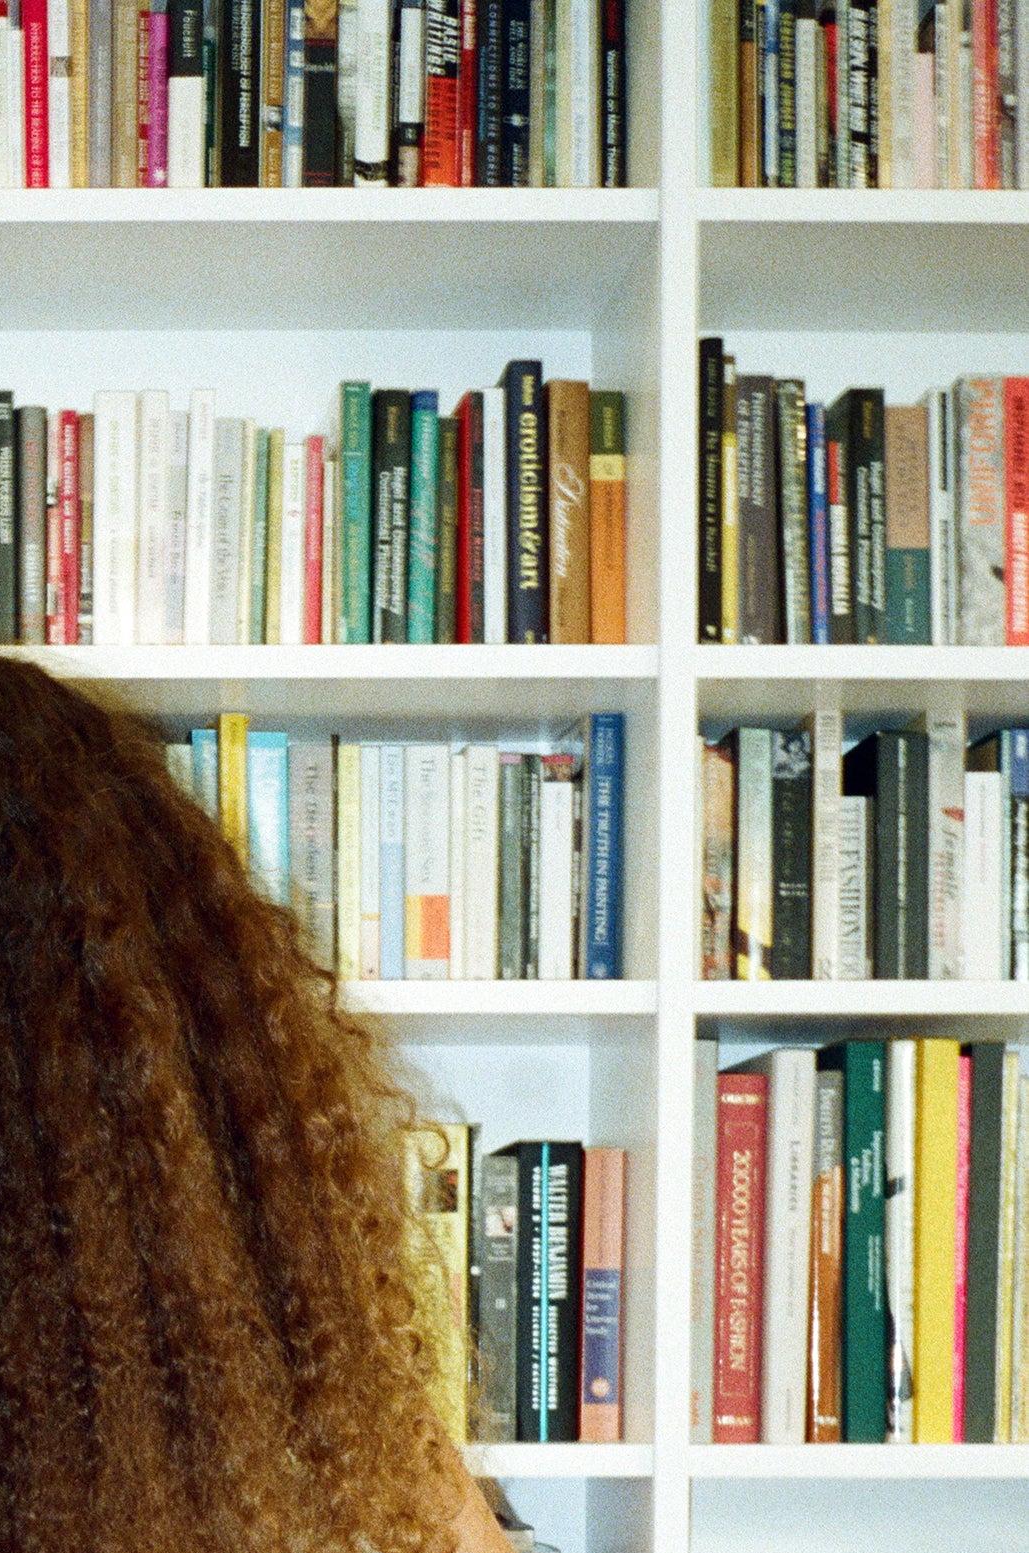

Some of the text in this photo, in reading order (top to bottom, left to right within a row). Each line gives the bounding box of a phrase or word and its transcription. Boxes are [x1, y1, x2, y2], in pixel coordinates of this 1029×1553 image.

[181, 10, 196, 58] Foucault
[486, 3, 497, 185] CONNECTIONS TO THE WORLD
[605, 50, 618, 96] Variations
[605, 99, 615, 111] on
[238, 92, 251, 147] PERCEPTION
[605, 114, 618, 143] Media
[217, 474, 232, 495] The
[968, 380, 997, 525] UNIFORM
[391, 502, 407, 526] and
[552, 463, 584, 578] Distinction
[472, 766, 486, 842] The Gift
[593, 781, 610, 942] THE TRUTH IN PAINTING
[839, 849, 861, 938] FASHION
[548, 1164, 567, 1223] WALTER
[787, 1140, 802, 1213] LIBRARIES
[547, 1226, 567, 1300] BENJAMIN
[728, 1219, 751, 1370] YEARS OF FASHION
